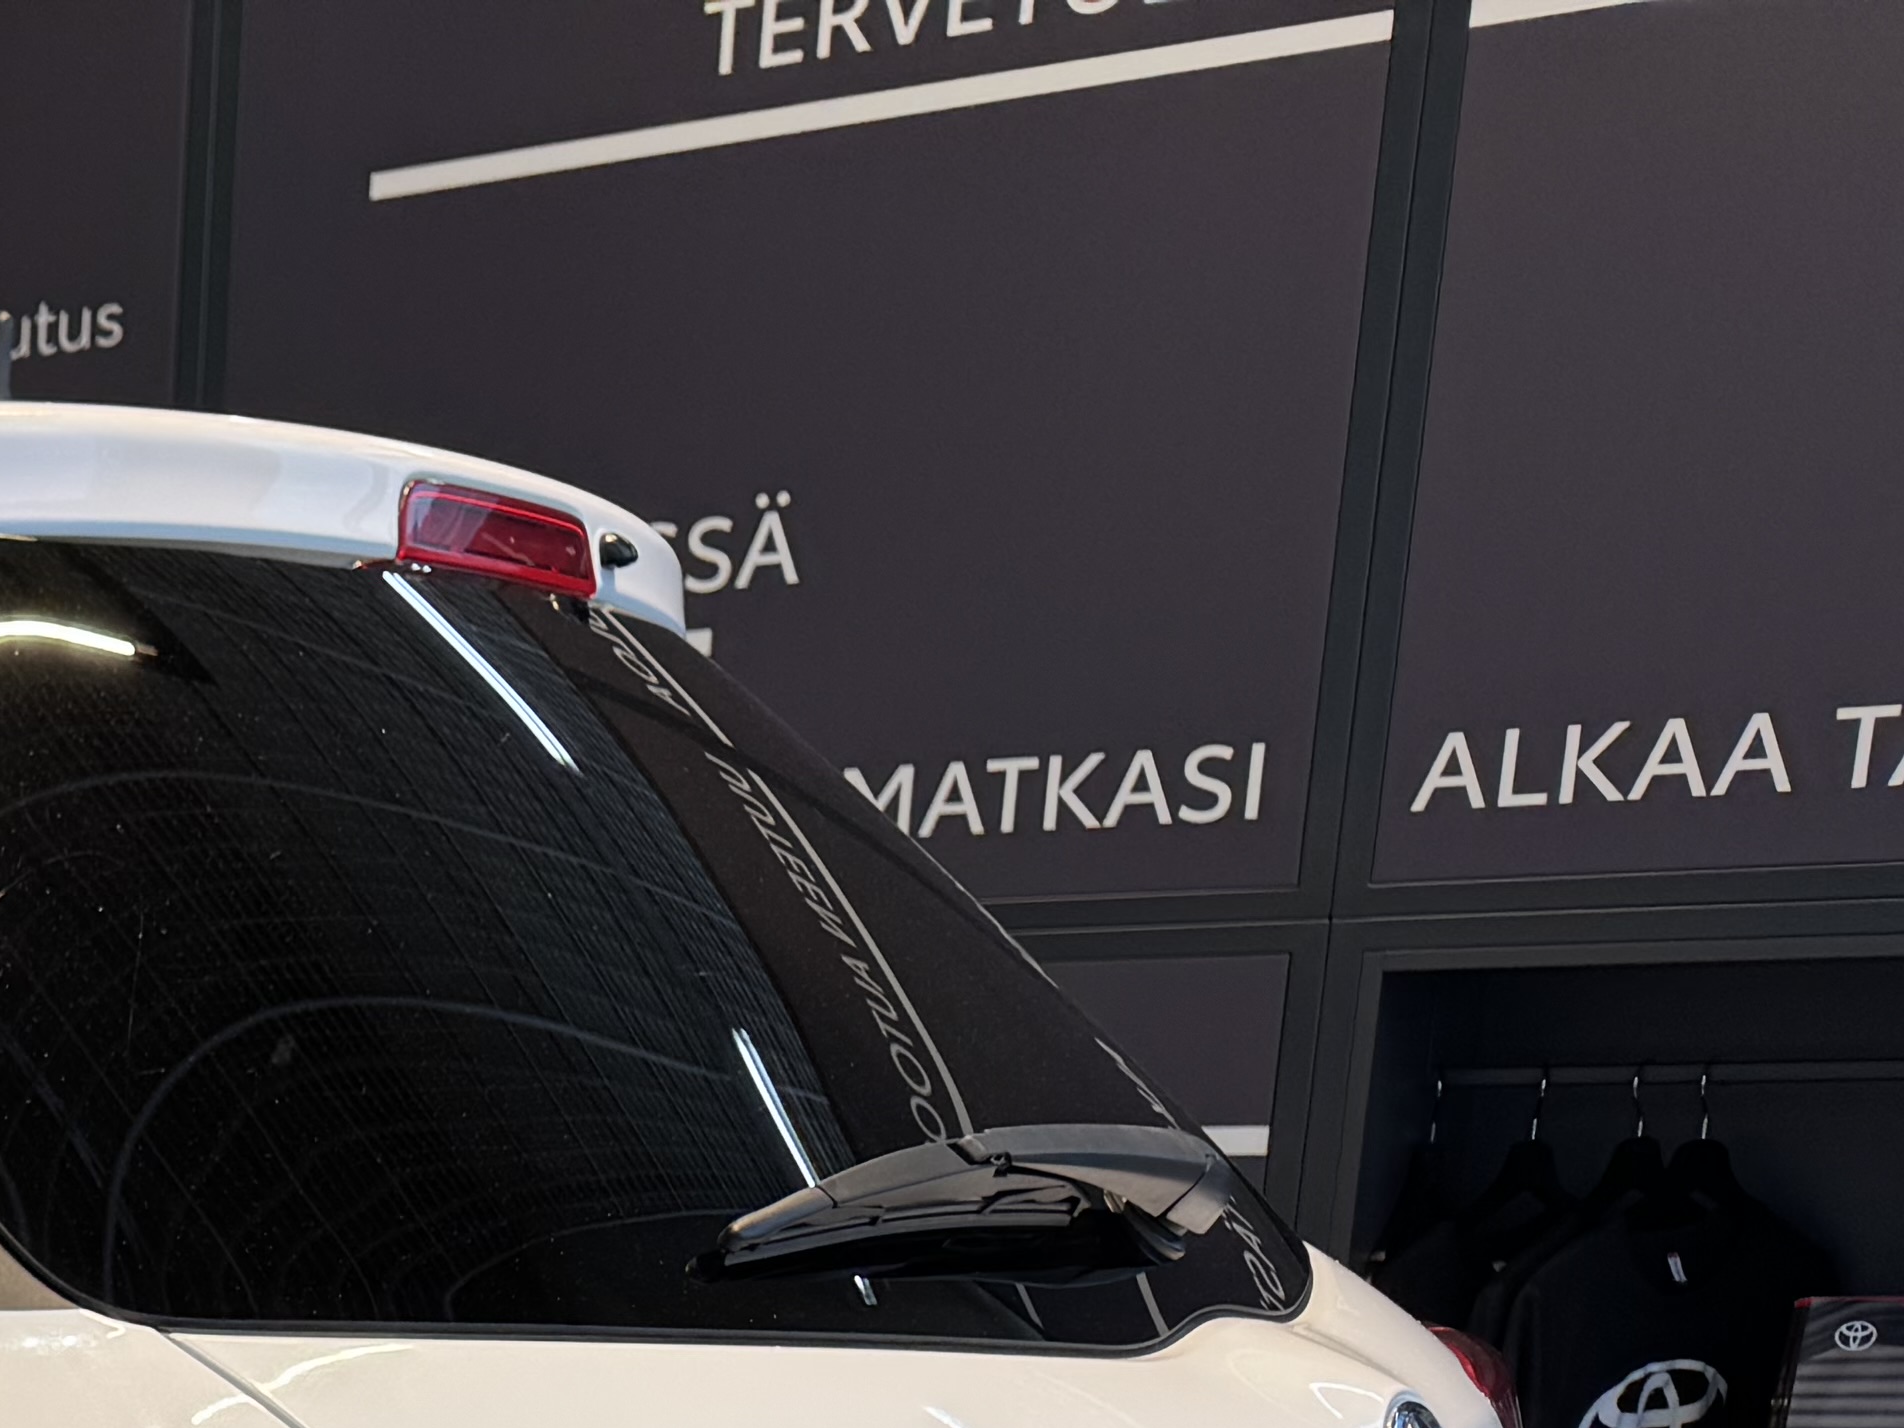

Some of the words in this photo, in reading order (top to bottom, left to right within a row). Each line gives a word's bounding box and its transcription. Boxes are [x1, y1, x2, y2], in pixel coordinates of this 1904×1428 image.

[703, 0, 1190, 76] TERVE
[649, 489, 800, 594] SÄ
[843, 742, 1267, 839] MATKASI
[1410, 711, 1792, 812] ALKAA
[1836, 703, 1904, 789] T
